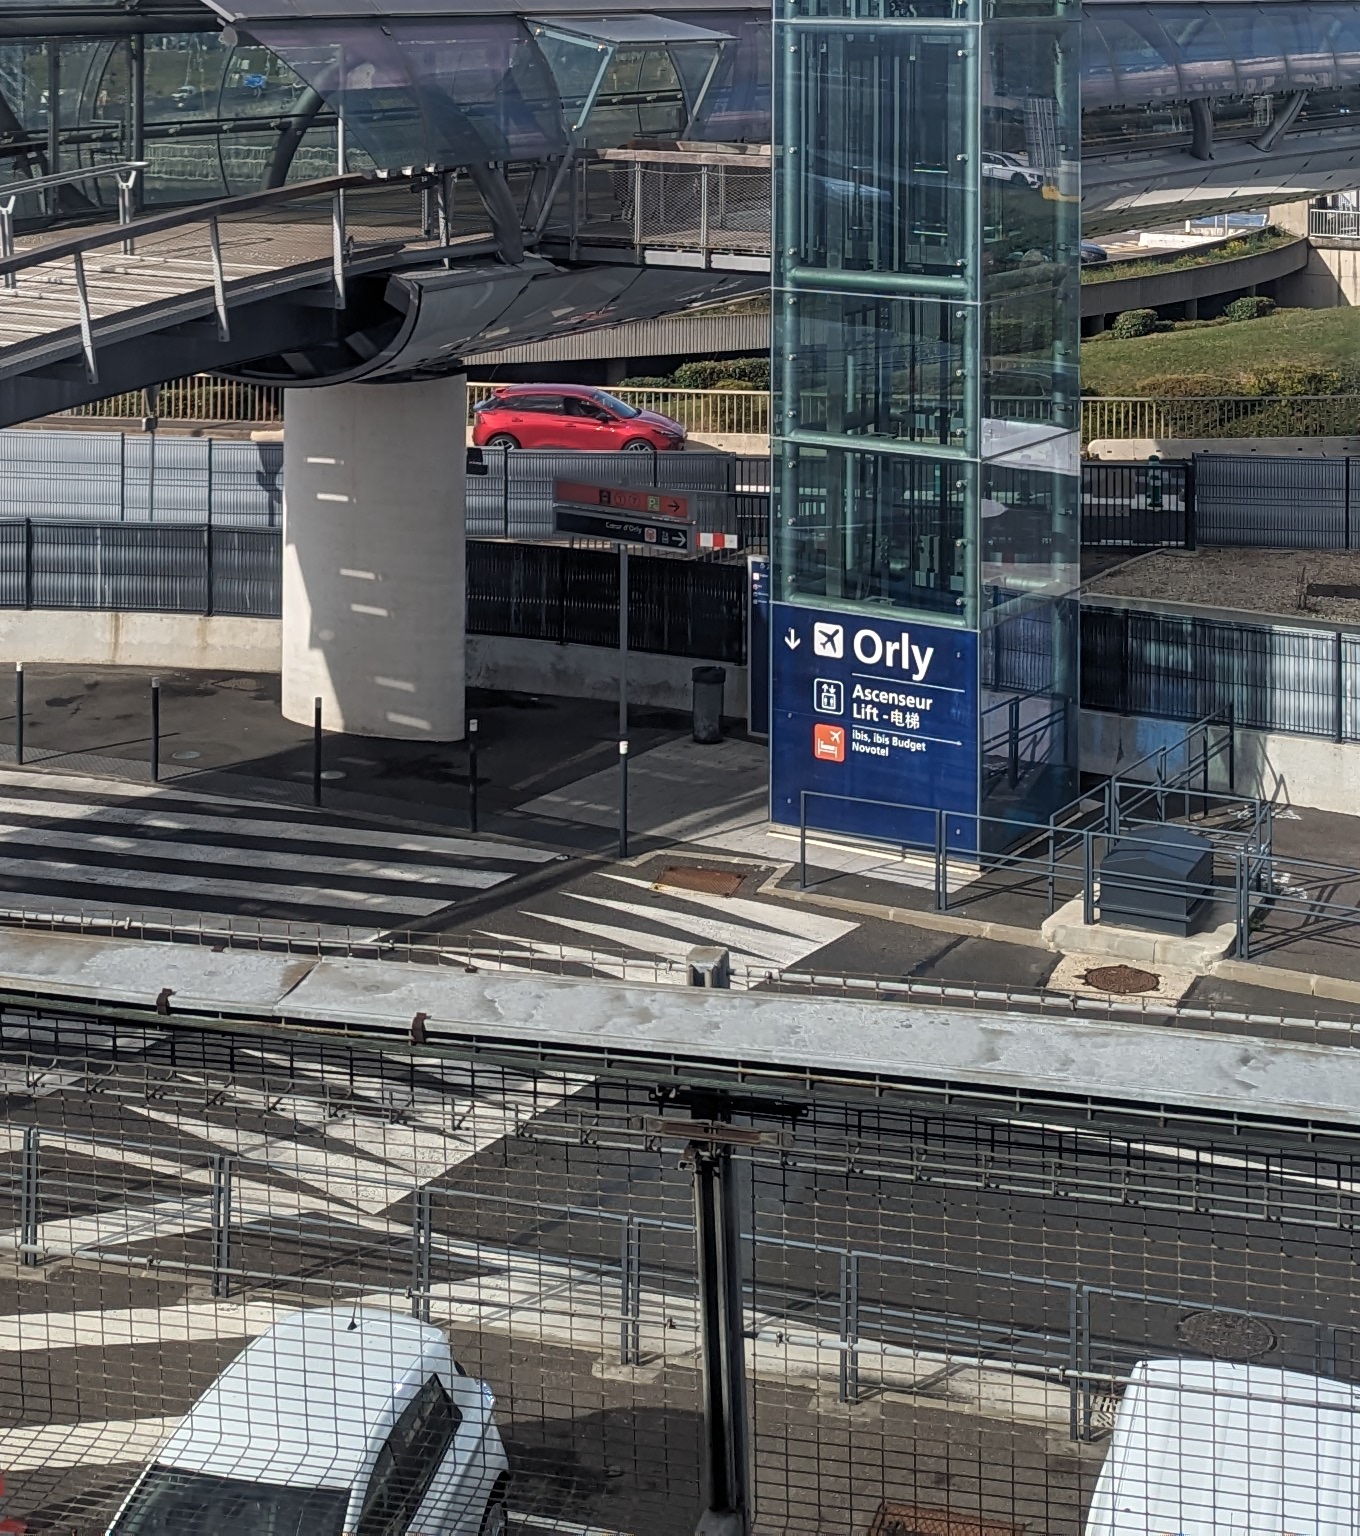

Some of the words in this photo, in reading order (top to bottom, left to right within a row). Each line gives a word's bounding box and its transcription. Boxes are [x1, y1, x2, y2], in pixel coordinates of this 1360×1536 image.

[853, 628, 935, 682] Orly
[851, 683, 934, 711] Ascenseur
[852, 702, 880, 722] Lift
[890, 709, 920, 730] 电梯
[851, 741, 890, 757] Novotel
[892, 736, 927, 753] Budget
